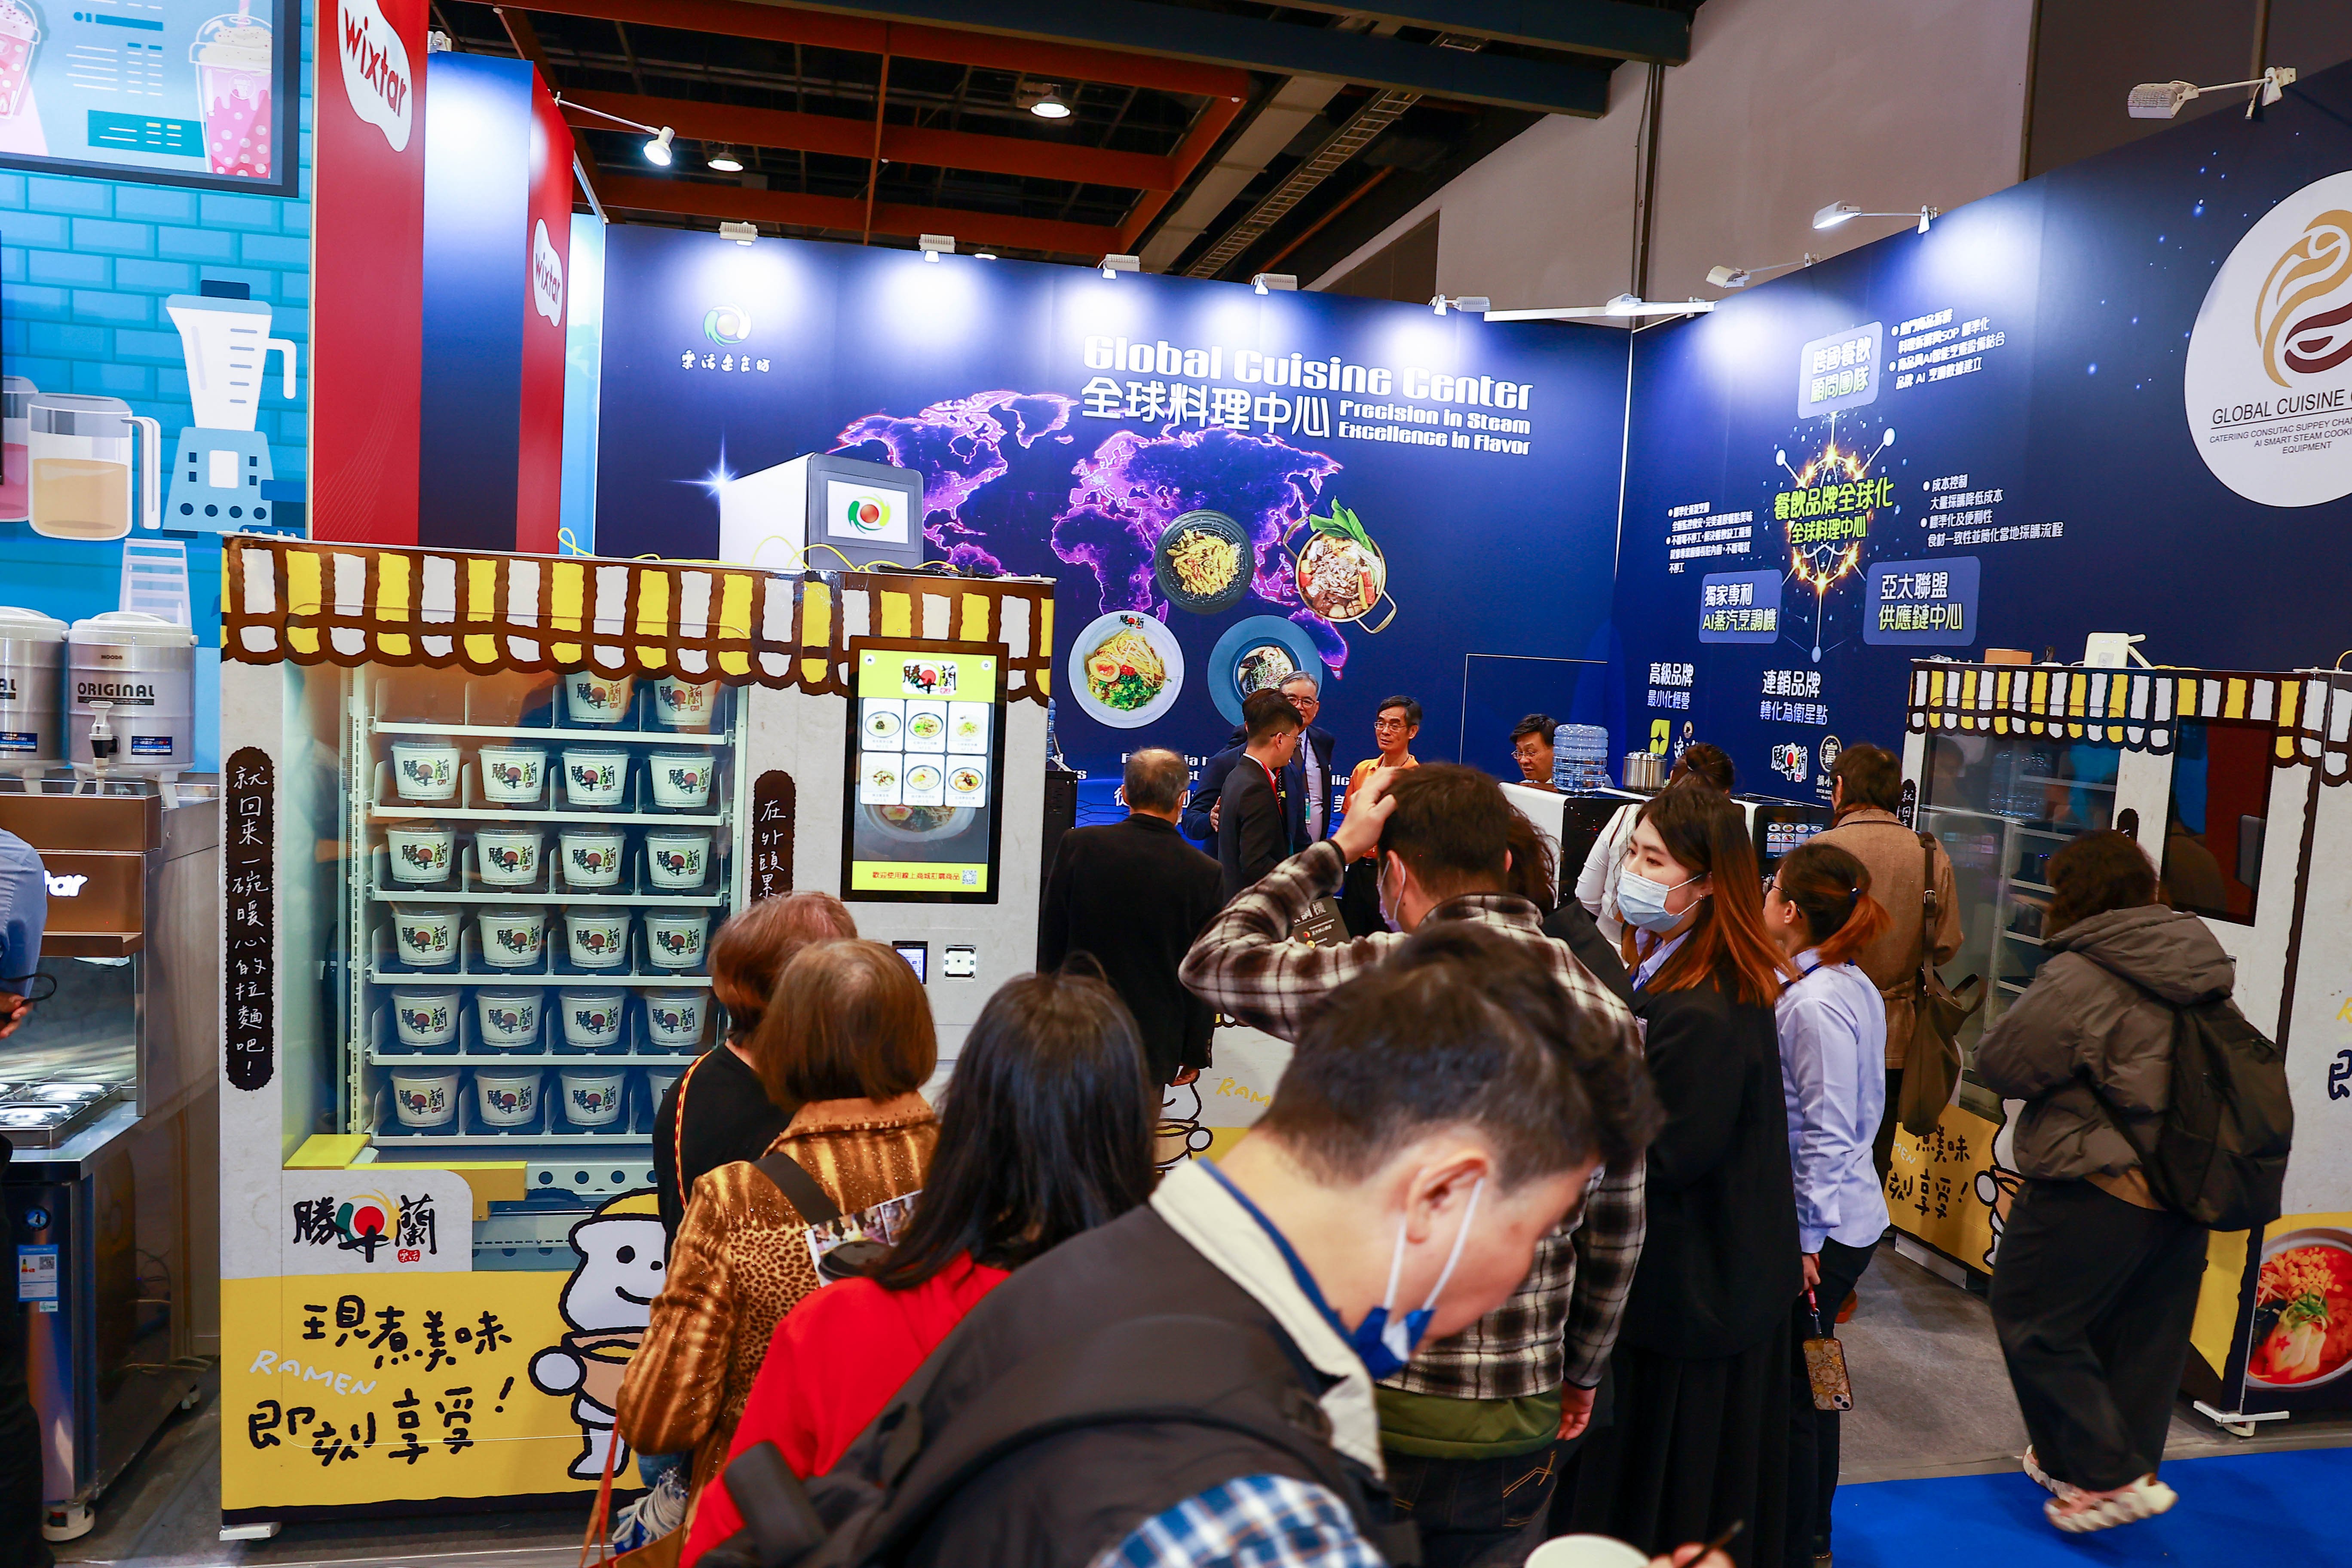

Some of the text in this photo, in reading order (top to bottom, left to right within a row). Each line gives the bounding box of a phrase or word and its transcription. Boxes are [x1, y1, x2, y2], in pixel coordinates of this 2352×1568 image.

[344, 6, 406, 118] wixtar
[536, 252, 560, 305] wixtar
[1084, 335, 1534, 410] Global Cuisine Center
[1915, 372, 1926, 384] AI
[1081, 376, 1331, 438] 全球料理中心
[1339, 399, 1531, 435] Precision in Steam
[2213, 389, 2345, 424] GLOBAL CUISINE
[1338, 421, 1531, 455] Excellence in Flavor
[2264, 435, 2292, 446] SMART
[2293, 432, 2322, 442] STEAM
[1932, 474, 1969, 492] 成本控制
[1774, 477, 1894, 520] 餐飲品牌全球化
[1929, 488, 2003, 510] 大量採購降低成本
[1791, 515, 1867, 544] 全球料理中心
[1929, 509, 1993, 529] 標準化及便利性
[1928, 522, 2064, 547] 食材一致性並簡化當地採購流程
[1705, 583, 1753, 606] 獨家專利
[1880, 572, 1948, 600] 亞太聯盟
[1702, 608, 1777, 631] AI蒸汽烹調機
[1879, 603, 1962, 630] 供應鏈中心
[1649, 662, 1694, 687] 高級品牌
[1762, 670, 1821, 698] 連鎖品牌
[78, 682, 155, 697] ORIGINAL
[1648, 689, 1690, 709] 最小化經營
[1760, 701, 1828, 725] 轉化為衛星點
[1216, 1078, 1270, 1107] RAM
[1893, 1142, 1916, 1164] MEN
[1889, 1168, 1968, 1219] 刻享受！
[302, 1295, 512, 1372] 現煮美味
[250, 1350, 377, 1396] RAMEN
